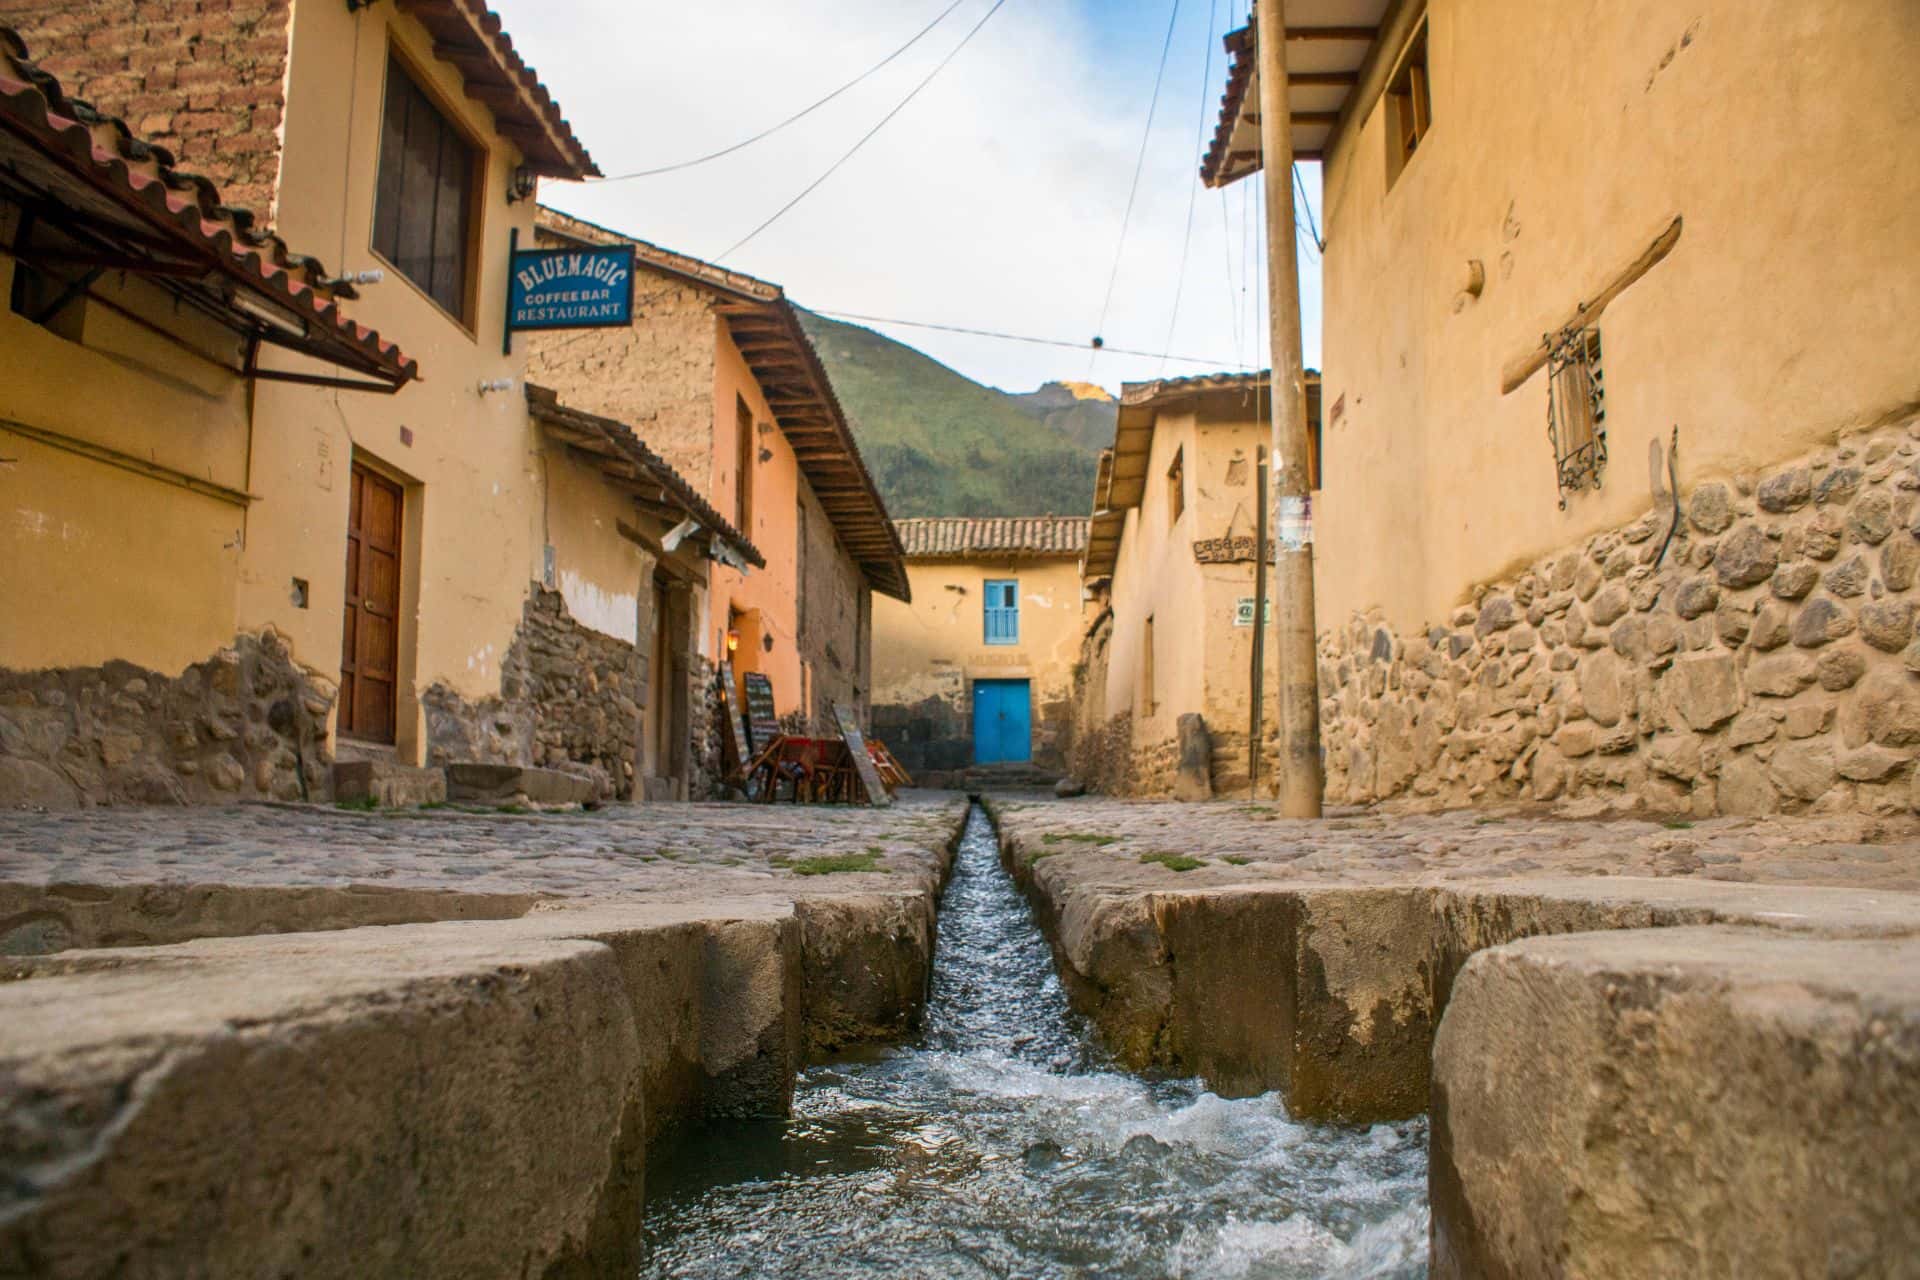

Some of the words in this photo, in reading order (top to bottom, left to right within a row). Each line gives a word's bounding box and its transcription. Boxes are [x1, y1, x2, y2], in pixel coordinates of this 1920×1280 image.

[525, 291, 579, 305] COFFEE
[581, 288, 610, 301] BAR
[517, 303, 621, 321] RESTAURANT
